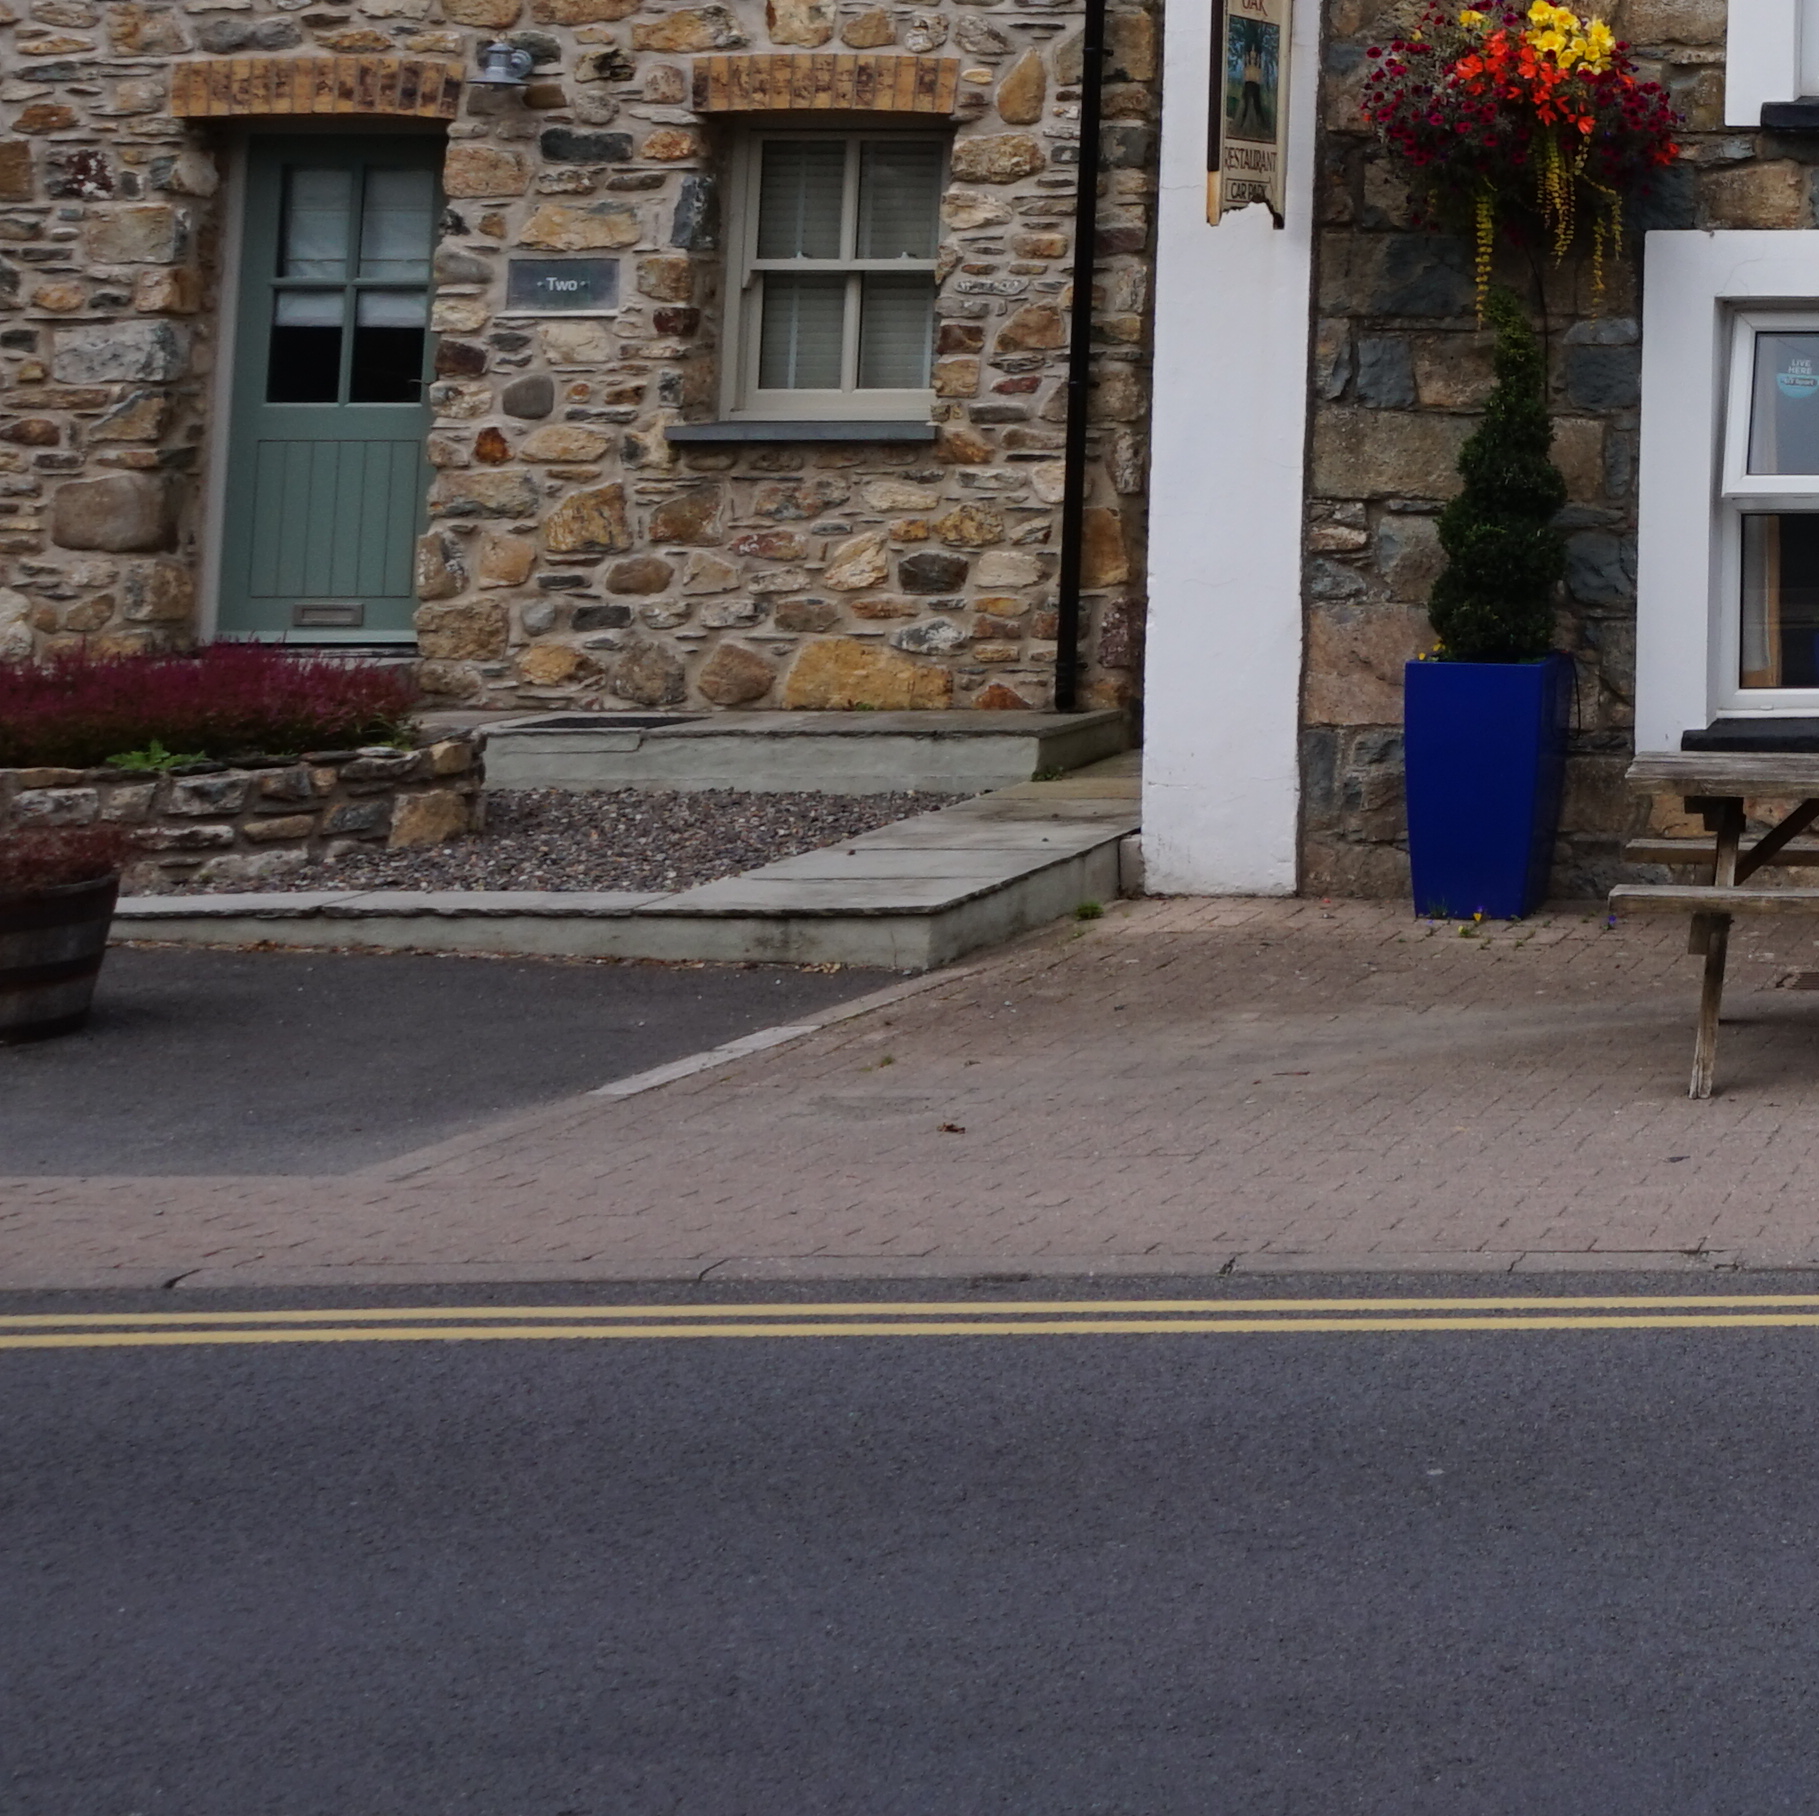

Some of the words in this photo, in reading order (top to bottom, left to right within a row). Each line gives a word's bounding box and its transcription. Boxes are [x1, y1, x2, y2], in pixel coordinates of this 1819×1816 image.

[1231, 182, 1246, 199] CAR
[545, 277, 578, 291] Two
[1792, 359, 1811, 367] LIVE
[1788, 366, 1812, 374] HERE
